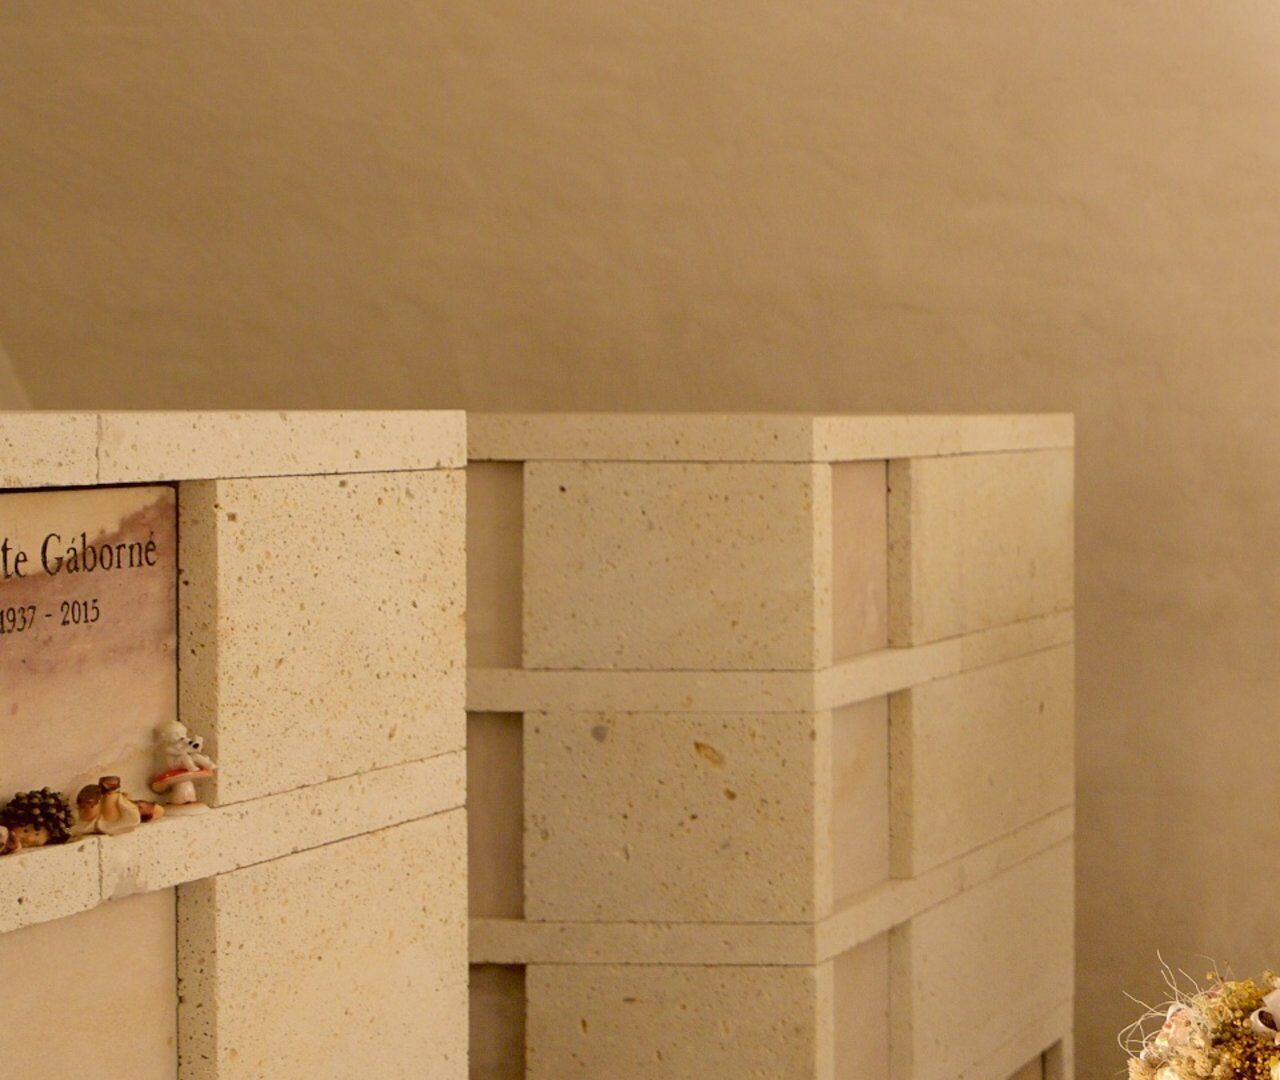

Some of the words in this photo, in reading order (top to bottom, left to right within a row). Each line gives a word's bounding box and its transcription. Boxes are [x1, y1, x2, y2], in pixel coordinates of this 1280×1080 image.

[41, 530, 158, 577] Gáborné
[0, 605, 37, 634] 1937
[60, 598, 101, 626] 2015
